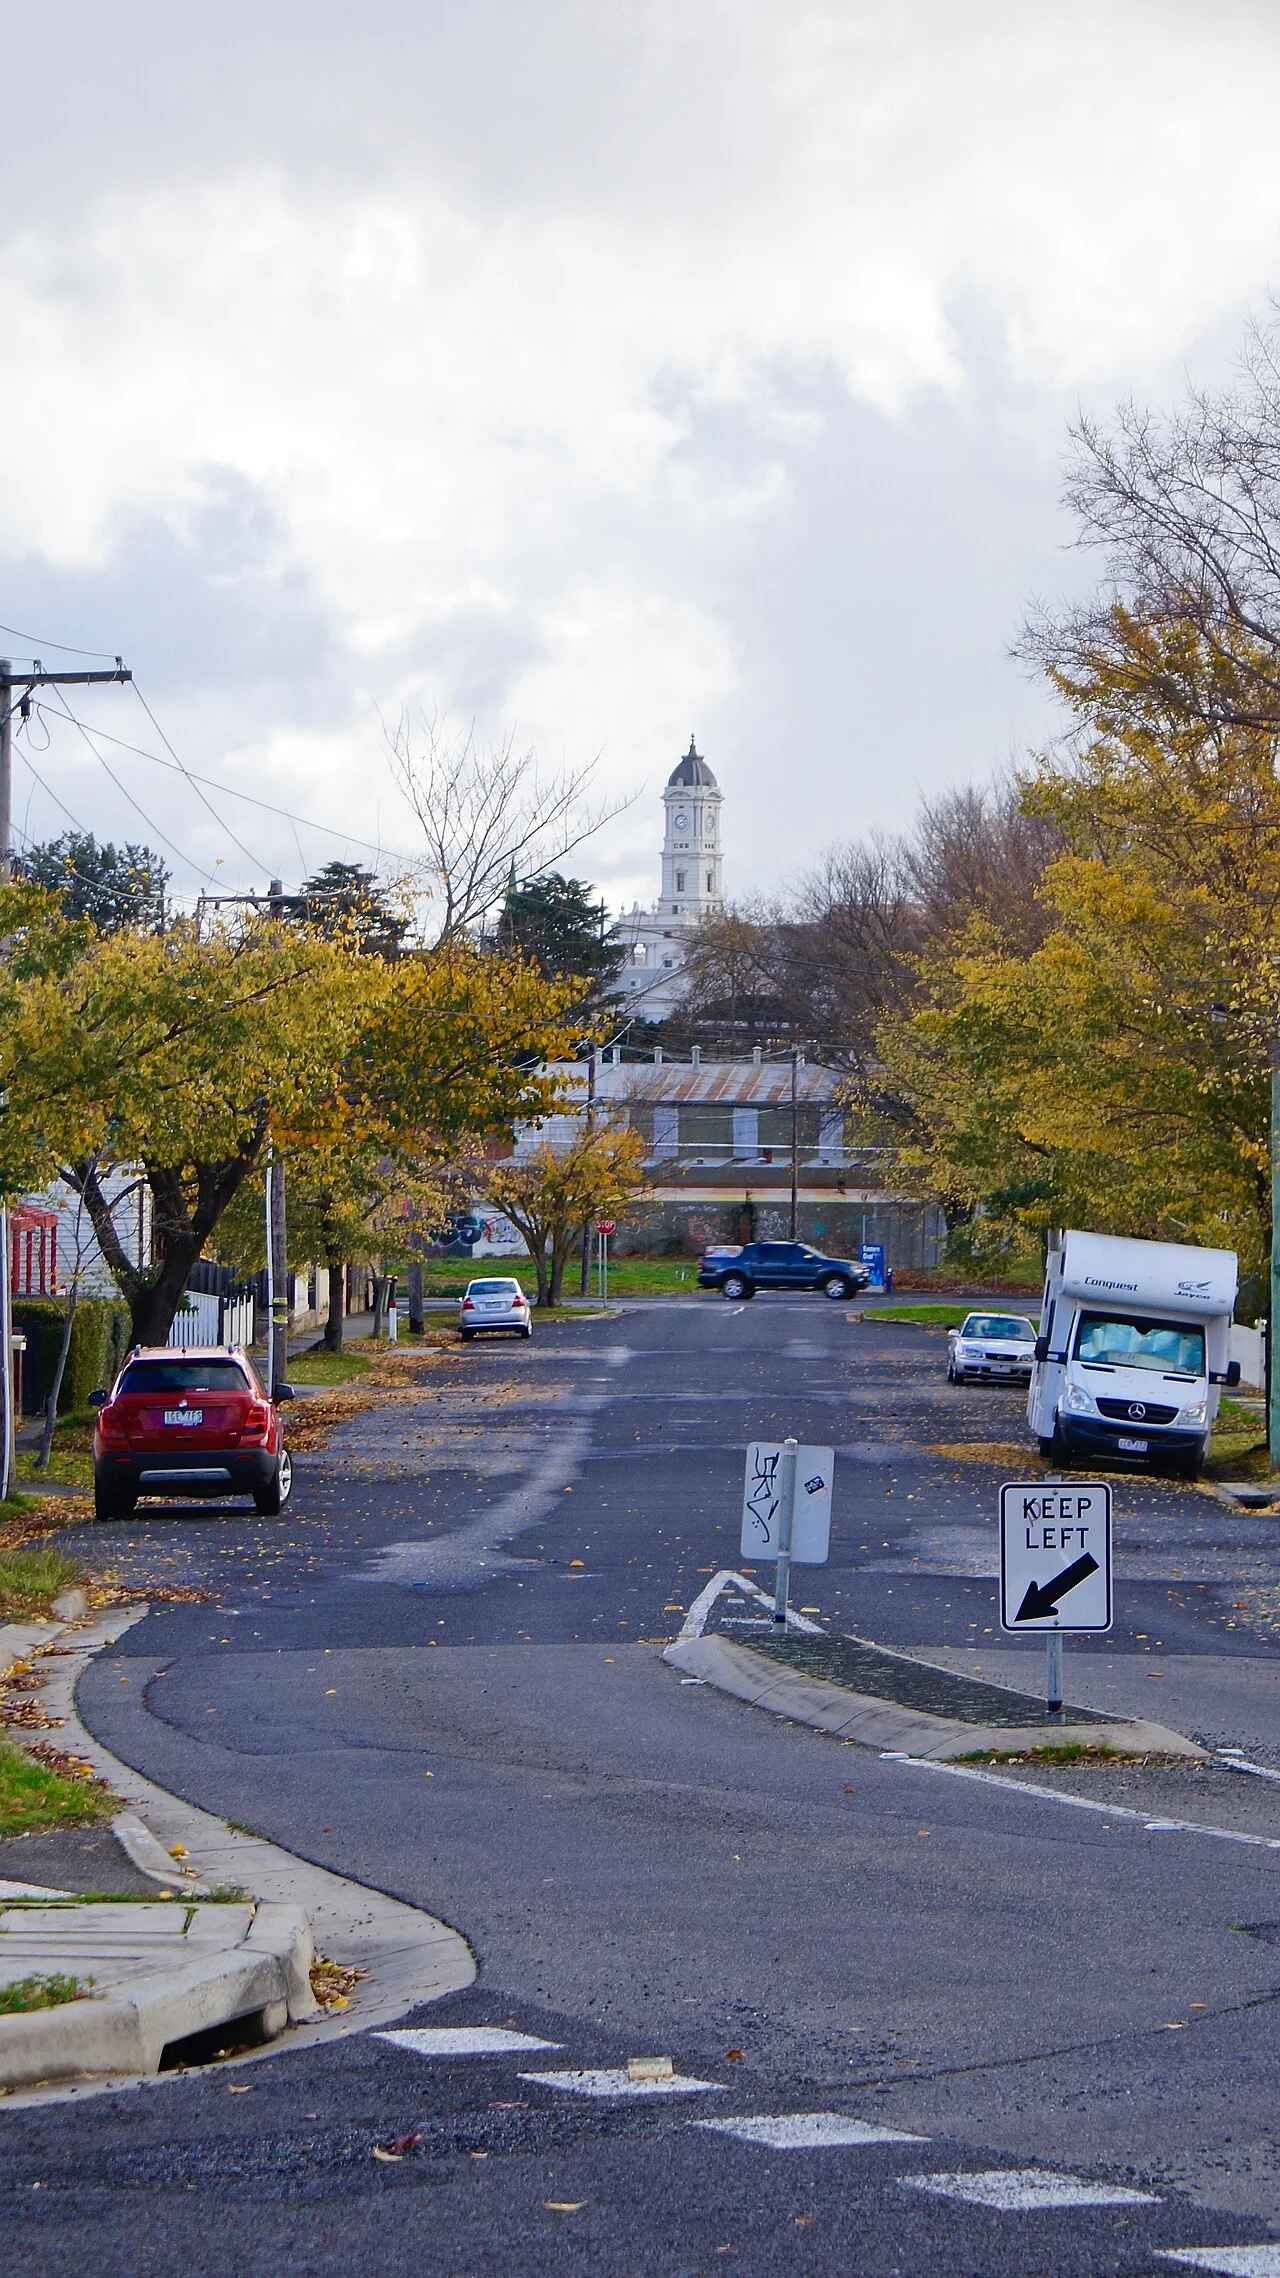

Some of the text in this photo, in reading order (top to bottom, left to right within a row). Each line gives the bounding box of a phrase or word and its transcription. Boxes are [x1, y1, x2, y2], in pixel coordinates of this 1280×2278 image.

[1084, 1276, 1138, 1291] Conquest
[1174, 1291, 1210, 1299] Jayco
[1023, 1497, 1092, 1519] KEEP
[1026, 1528, 1089, 1549] LEFT
